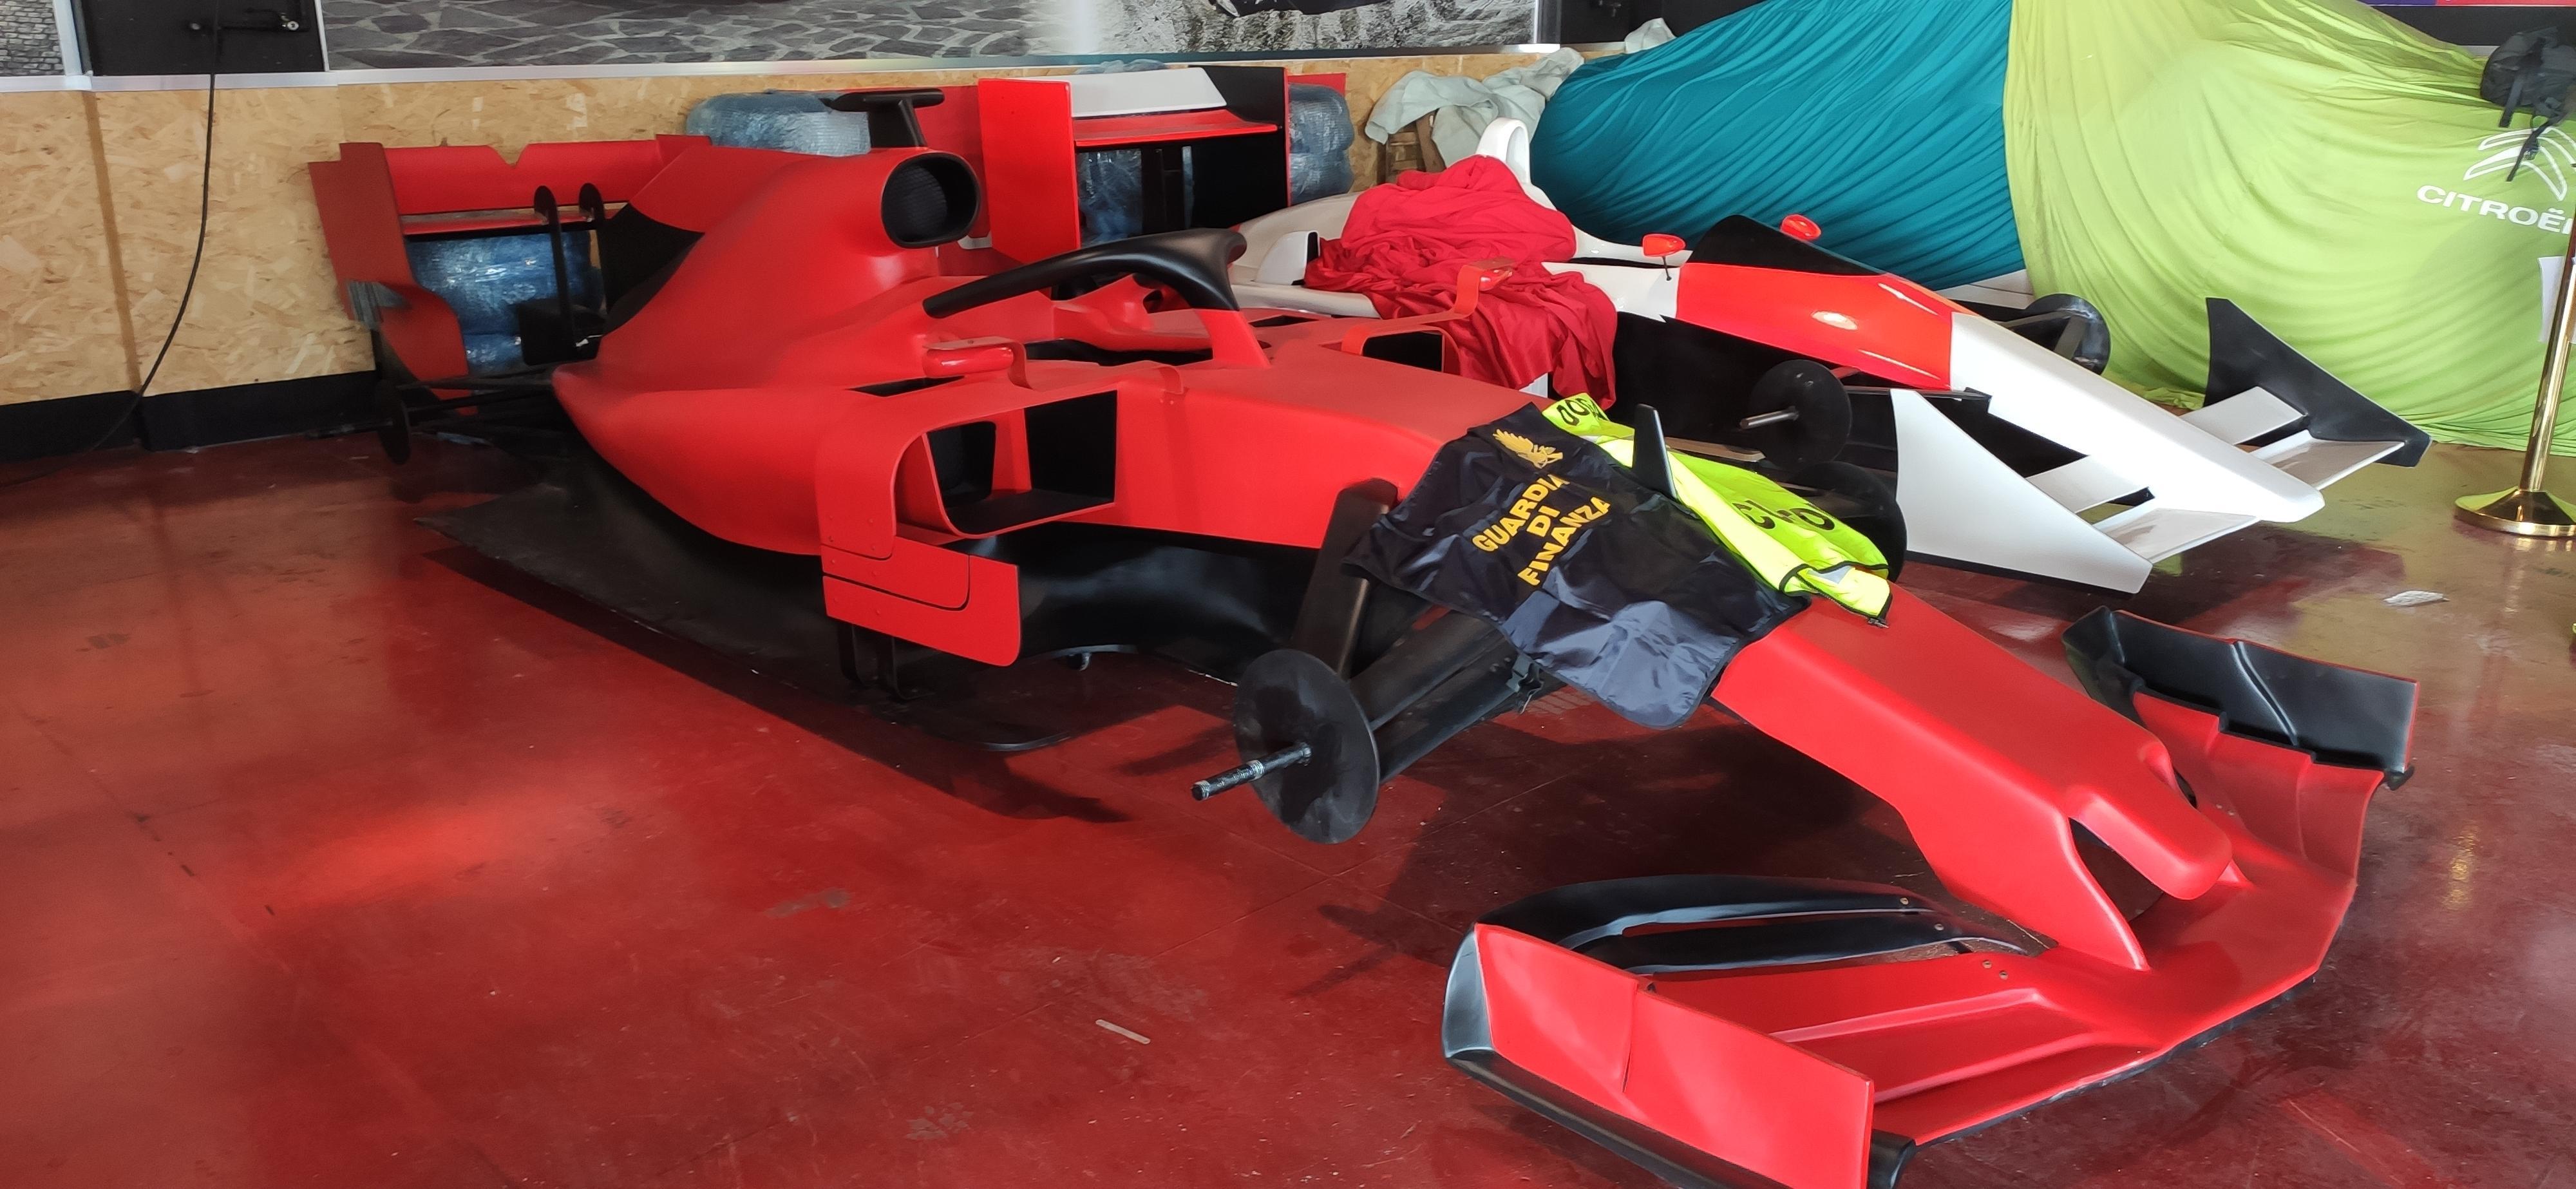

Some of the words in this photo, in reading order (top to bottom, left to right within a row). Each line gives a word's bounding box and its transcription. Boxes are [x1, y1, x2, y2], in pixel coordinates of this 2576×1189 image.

[1472, 474, 1570, 551] GUARDIA
[1517, 497, 1611, 585] FINANZA
[1526, 505, 1560, 537] DI
